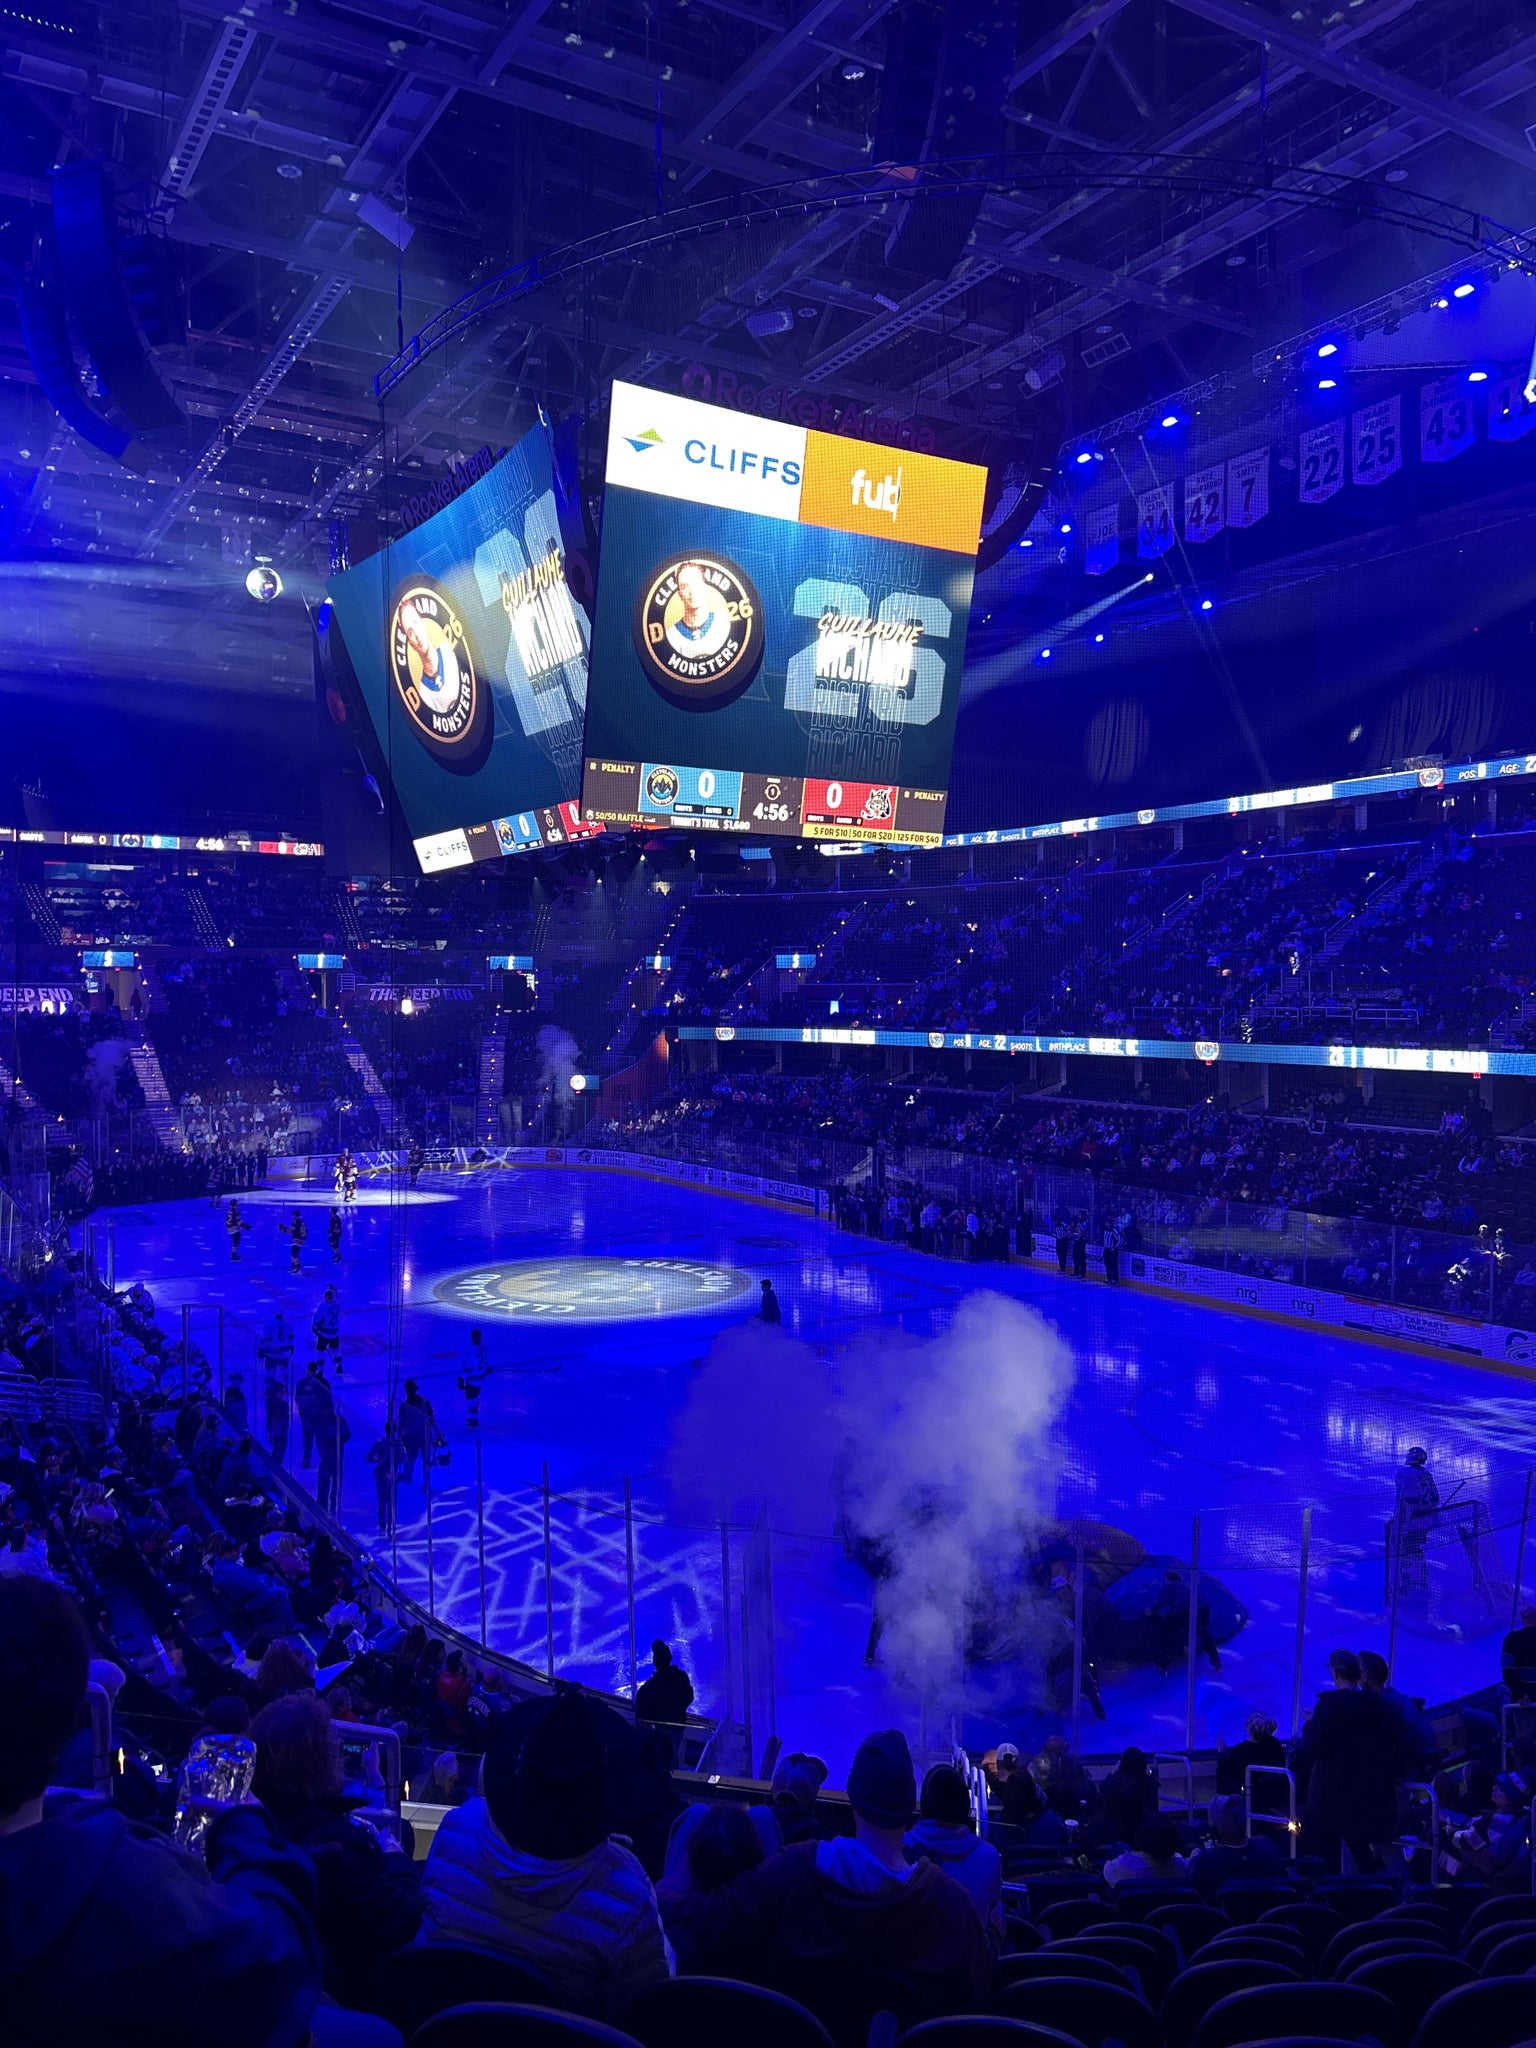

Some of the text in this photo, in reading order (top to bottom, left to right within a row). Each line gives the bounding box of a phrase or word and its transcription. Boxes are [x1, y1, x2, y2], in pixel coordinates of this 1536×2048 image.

[716, 369, 936, 451] Rocket Arena
[1425, 401, 1467, 446] 43
[1358, 425, 1396, 474] 25
[684, 439, 801, 486] CLIFFS
[1304, 447, 1339, 492] 22
[411, 445, 495, 524] Rocket Arena
[1241, 477, 1256, 513] 7
[1189, 491, 1220, 529] 42
[502, 547, 564, 614] GUILLAUME
[726, 597, 754, 622] 26
[441, 615, 464, 648] 26
[649, 622, 665, 644] D
[818, 611, 924, 646] GUILLAUME
[667, 638, 739, 676] MONSTERS
[405, 686, 421, 712] D
[433, 671, 471, 733] MONSTERS
[805, 727, 902, 783] RICHARD
[601, 763, 635, 774] PENALTY
[1499, 763, 1521, 774] AGE:
[698, 770, 716, 799] 0
[826, 780, 843, 809] 0
[913, 791, 945, 801] PENALTY
[595, 812, 617, 821] 50/50
[617, 812, 644, 822] RAFFLE
[753, 802, 789, 821] 4:56
[518, 814, 530, 838] 0
[814, 826, 940, 844] 5 FOR $10 50 FOR $20 125 FOR $40
[986, 830, 998, 843] 22
[98, 835, 107, 846] 0
[437, 841, 468, 857] CLIFFS
[0, 987, 74, 1003] EEP END
[369, 988, 400, 1002] THE
[442, 988, 475, 1002] END
[994, 1034, 1007, 1050] 22
[1035, 1036, 1042, 1051] L
[1049, 1042, 1087, 1053] BIRTHPLACE
[1236, 1286, 1258, 1305] nrg
[1292, 1298, 1315, 1317] nrg
